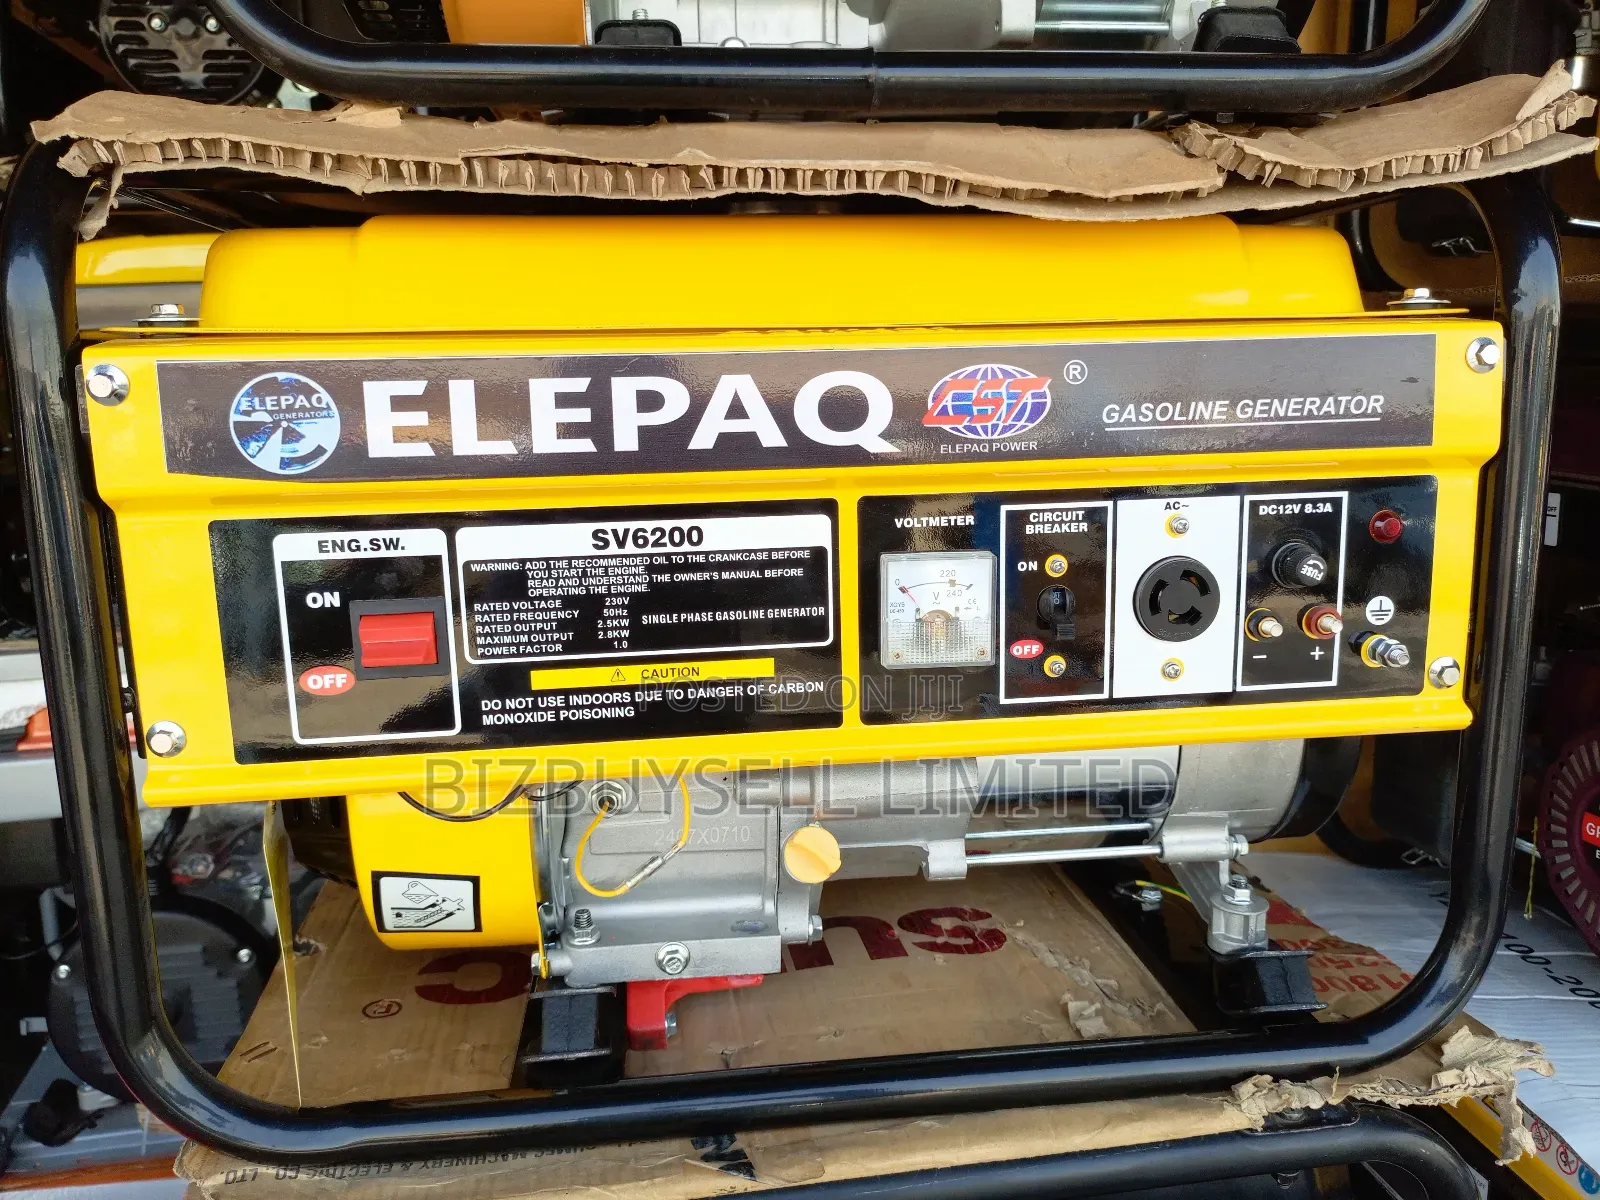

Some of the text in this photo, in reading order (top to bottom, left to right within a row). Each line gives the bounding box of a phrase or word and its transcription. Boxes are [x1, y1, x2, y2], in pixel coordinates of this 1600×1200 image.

[239, 393, 328, 411] ELEPAQ
[1102, 394, 1385, 424] GASOLINE GENERATOR
[273, 410, 335, 420] GENERATORS
[362, 370, 901, 458] ELEPAQ
[940, 441, 1038, 454] ELEPAQ POWER
[1029, 510, 1085, 523] CIRCUIT
[1258, 502, 1333, 516] DC12V 8.3A
[894, 515, 975, 529] VOLTMETER
[1025, 522, 1088, 535] BREAKER
[317, 537, 406, 554] ENG.SW.
[591, 525, 704, 551] SV6200
[471, 549, 811, 572] WARNING: ADD THE RECOMMENDED OIL TO THE CRANKCASE BEFORE
[1017, 561, 1038, 572] ON
[527, 565, 648, 579] YOU START THE ENGINE.
[528, 568, 804, 588] READ AND UNDERSTAND THE OWNER'S MANUAL BEFORE
[939, 570, 956, 578] 220
[1301, 563, 1325, 582] FUSE
[528, 583, 651, 597] OPERATING THE ENGINE.
[946, 589, 963, 598] 240
[305, 591, 341, 609] ON
[474, 597, 630, 611] RATED VOLTAGE 230V
[475, 608, 629, 622] RATED FREQUENCY 50Hz
[641, 606, 826, 625] SINGLE PHASE GASOLINE GENERATOR
[475, 618, 630, 634] RATED OUTPUT 2.5KW
[476, 629, 630, 645] MAXIMUM OUTPUT 2.8KW
[477, 640, 628, 656] POWER FACTOR 1.0
[1012, 644, 1040, 656] OFF
[641, 666, 700, 680] CAUTION
[306, 673, 348, 690] OFF
[481, 681, 824, 711] DO NOT USE INDOORS DUE TO DANGER OF CARBON
[482, 706, 635, 726] MONOXIDE POISONING
